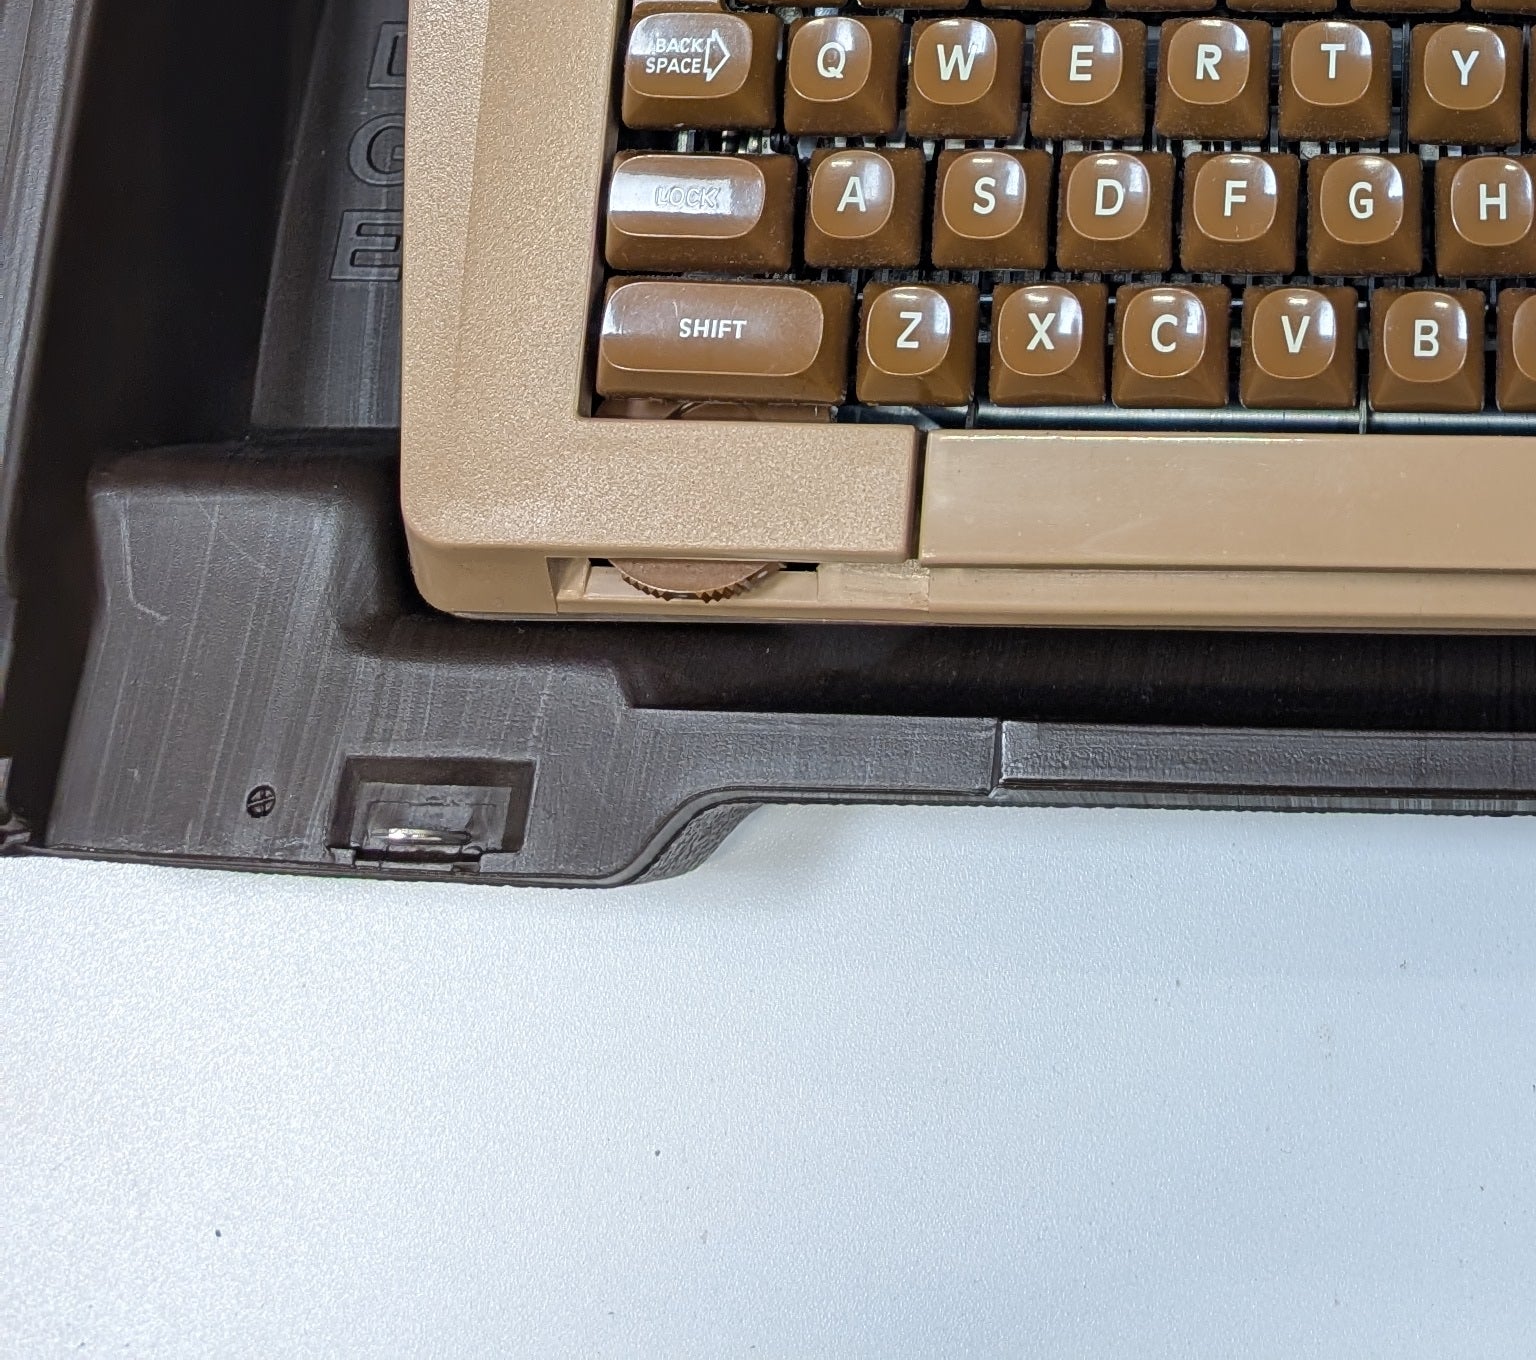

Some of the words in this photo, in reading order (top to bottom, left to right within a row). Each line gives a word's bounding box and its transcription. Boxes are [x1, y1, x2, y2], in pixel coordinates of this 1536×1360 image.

[654, 37, 704, 54] BACK
[816, 42, 845, 79] Q
[936, 44, 978, 81] W
[1069, 45, 1094, 82] E
[1196, 43, 1221, 80] R
[1320, 43, 1346, 79] T
[645, 57, 701, 74] SPACE
[1451, 50, 1480, 86] Y
[655, 187, 719, 210] LOCK
[837, 176, 866, 213] A
[973, 176, 996, 215] S
[1095, 178, 1124, 217] D
[1224, 180, 1247, 217] F
[1349, 181, 1374, 220] G
[1479, 183, 1507, 221] H
[679, 317, 747, 340] SHIFT
[896, 312, 922, 349] Z
[1026, 312, 1056, 350] X
[1151, 314, 1178, 353] C
[1281, 316, 1310, 353] V
[1413, 320, 1440, 357] B
